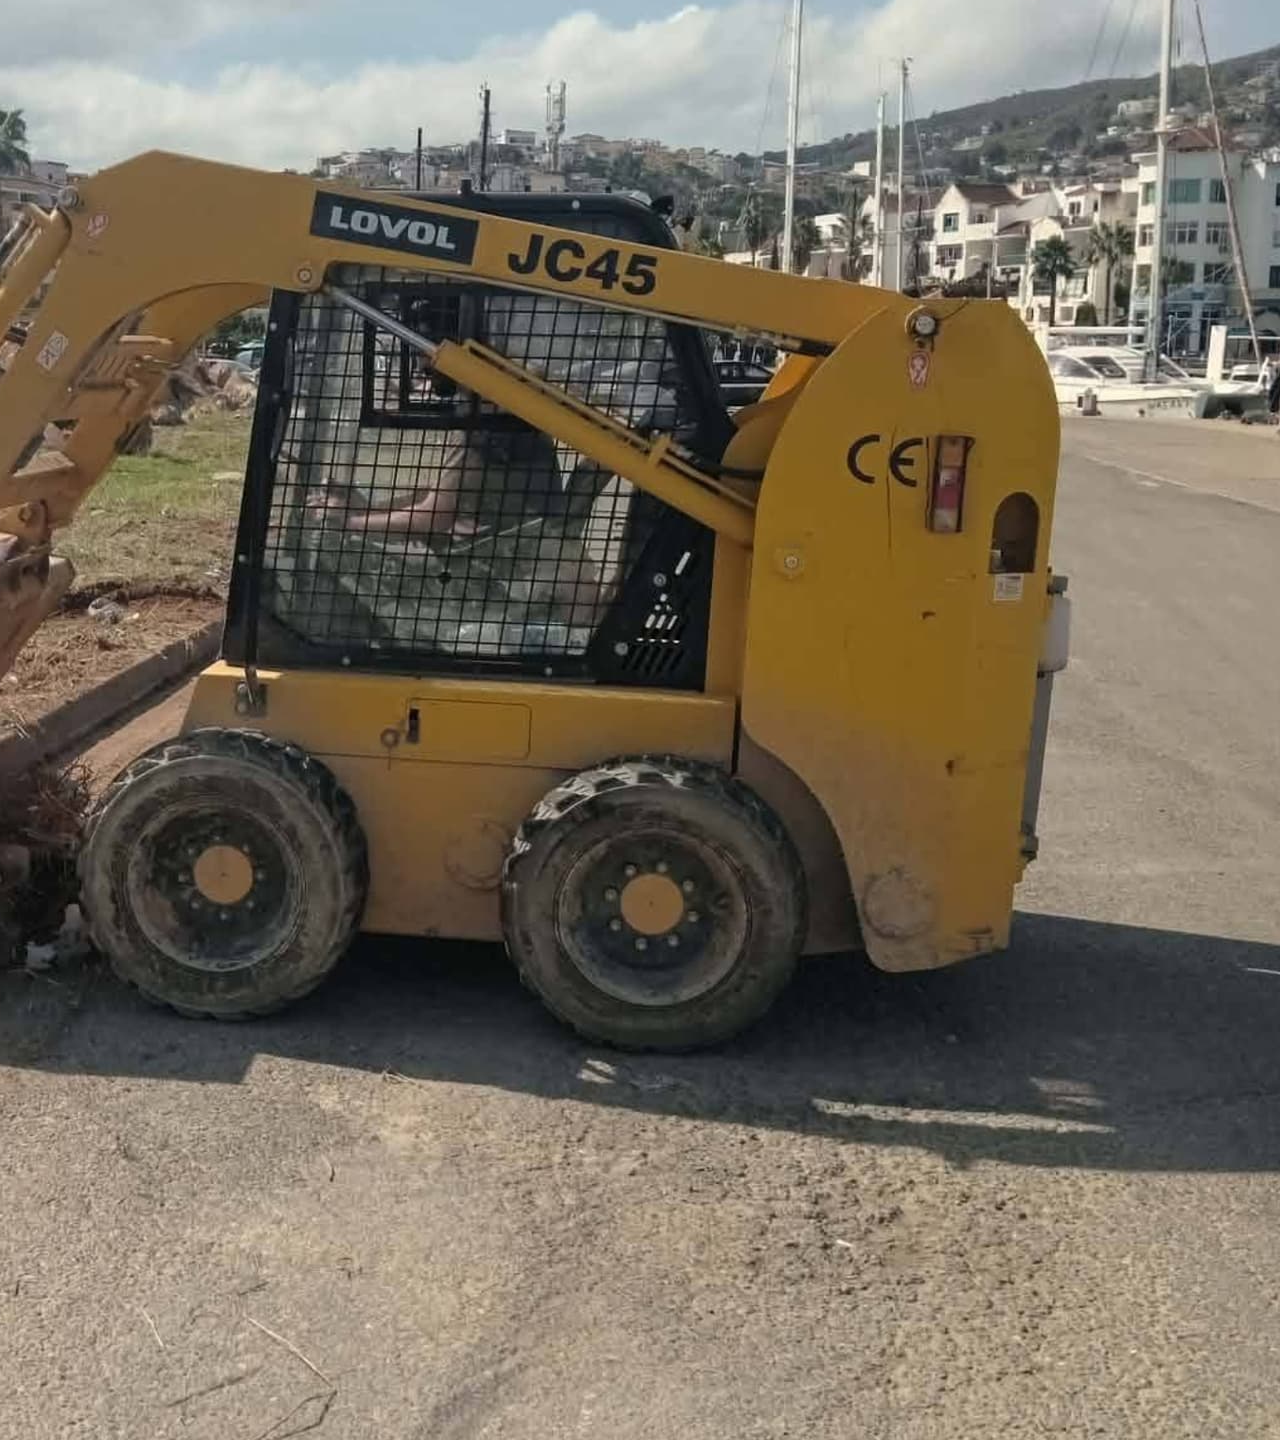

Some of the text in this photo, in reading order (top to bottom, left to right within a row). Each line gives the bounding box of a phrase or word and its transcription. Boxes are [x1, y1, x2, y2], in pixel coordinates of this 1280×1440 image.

[329, 205, 456, 251] LOVOL
[508, 234, 658, 295] JC45
[847, 434, 924, 488] CE
